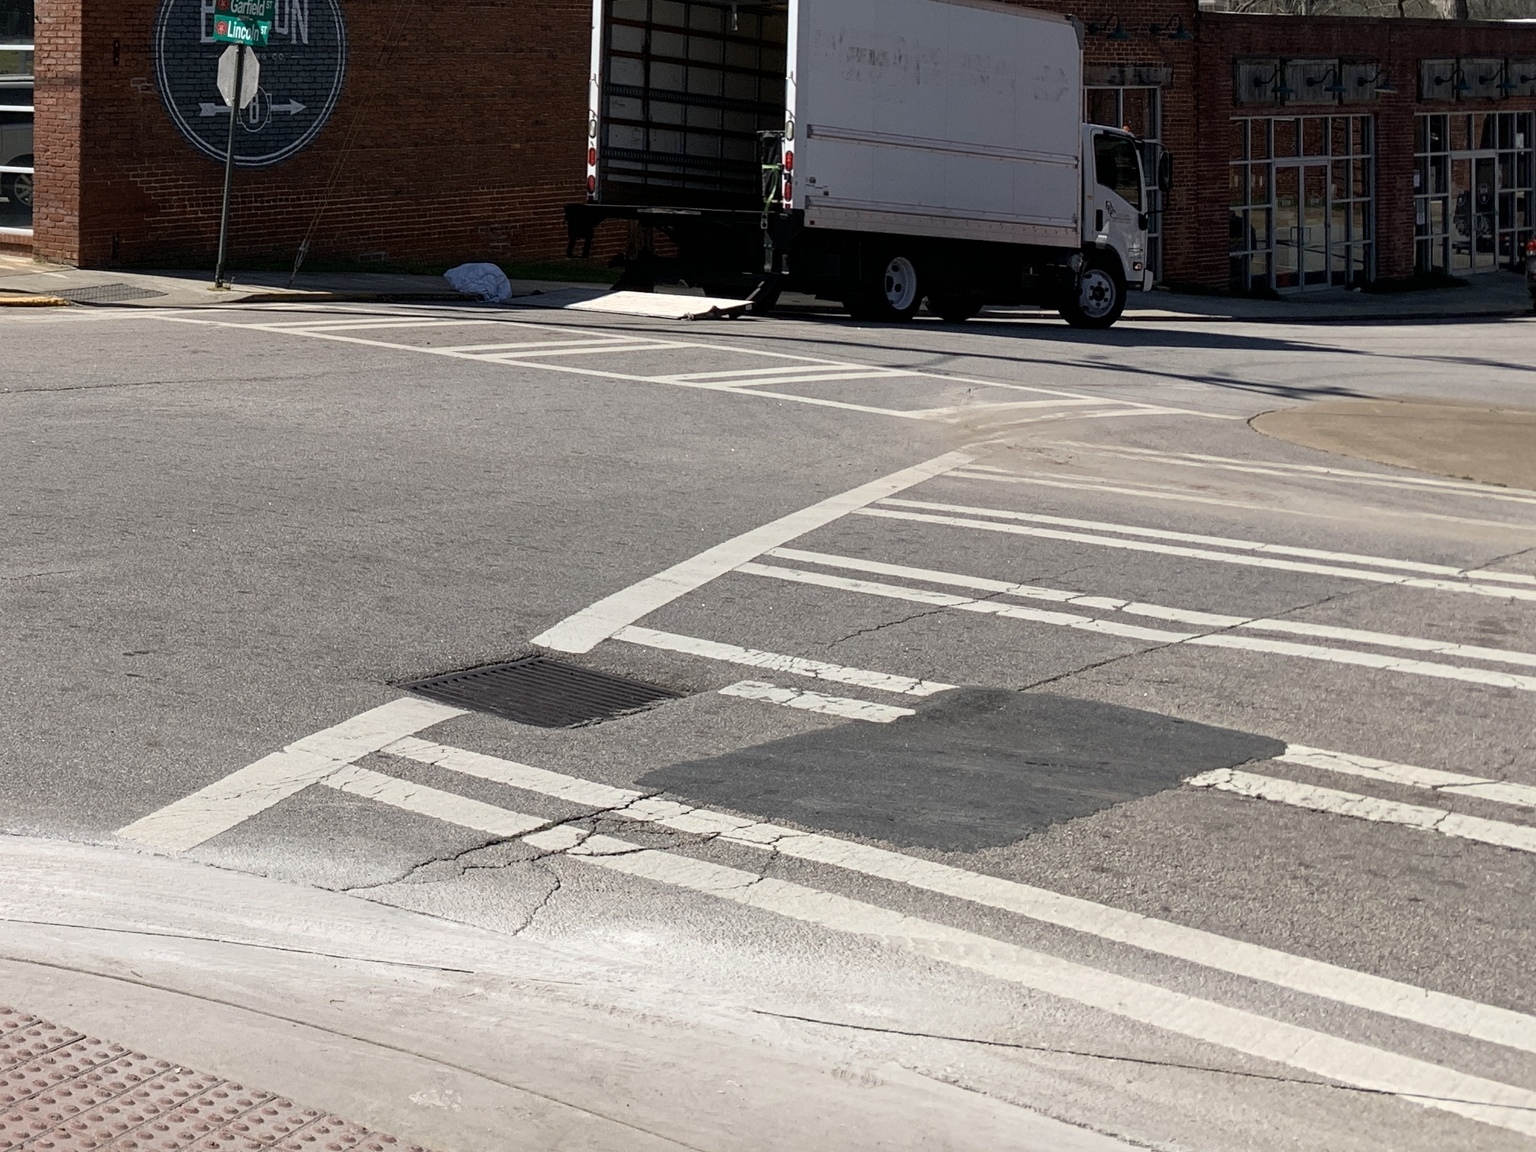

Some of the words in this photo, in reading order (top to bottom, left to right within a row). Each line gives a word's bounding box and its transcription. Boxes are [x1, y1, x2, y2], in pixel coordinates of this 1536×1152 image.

[266, 0, 274, 10] ST
[227, 20, 260, 42] Lincoln
[260, 25, 269, 36] ST
